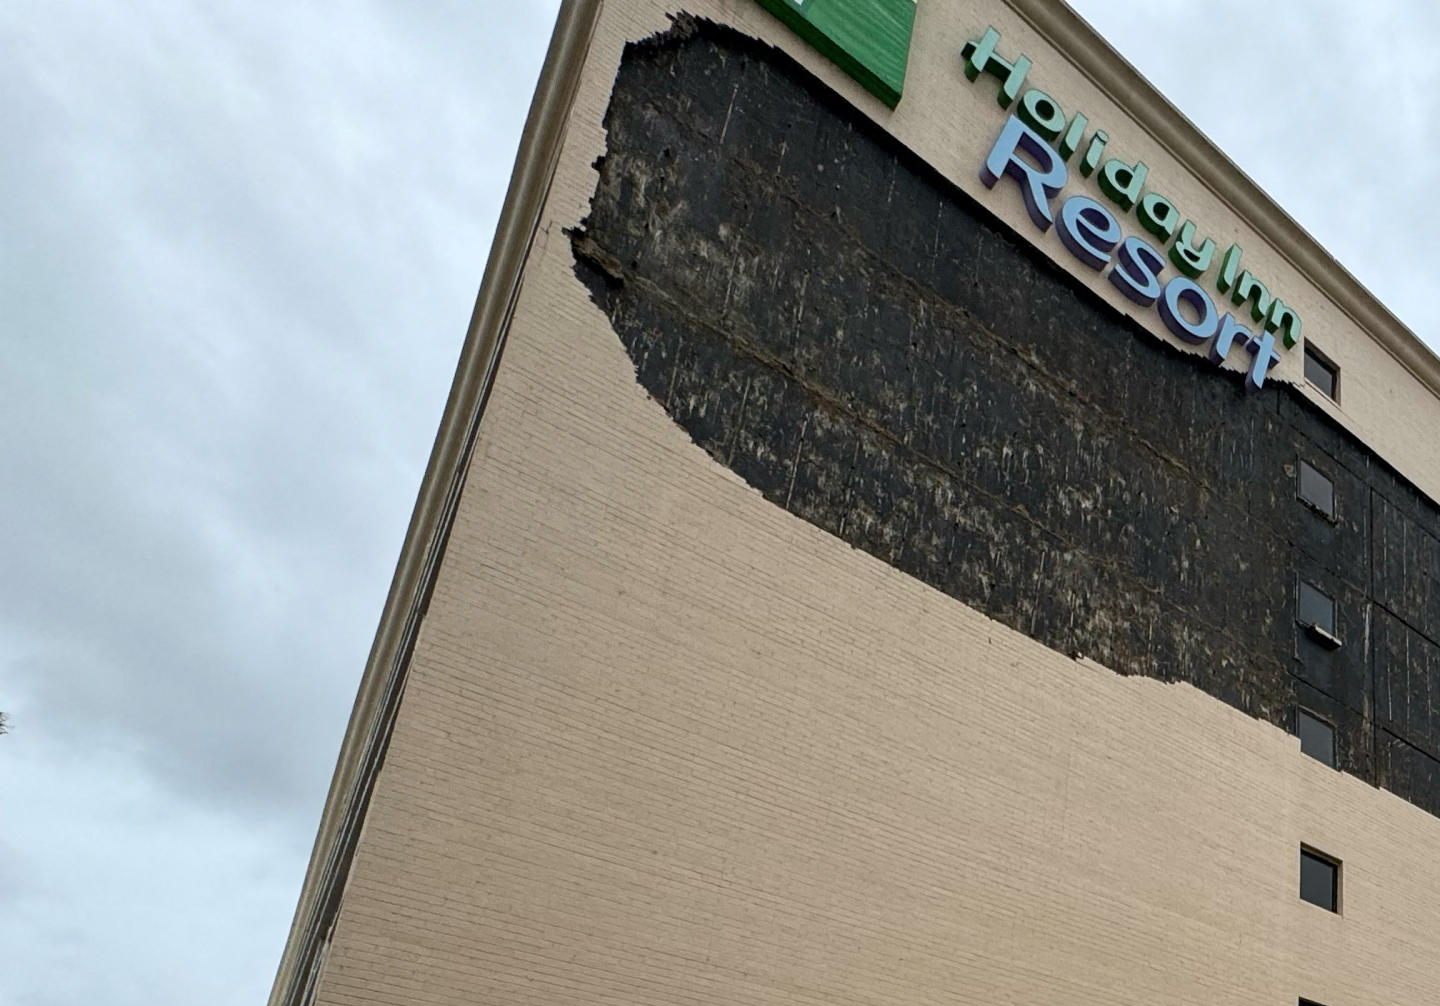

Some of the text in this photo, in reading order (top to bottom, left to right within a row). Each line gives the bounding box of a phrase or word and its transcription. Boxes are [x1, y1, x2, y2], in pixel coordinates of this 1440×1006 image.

[960, 25, 1302, 350] Holiday Inn
[979, 113, 1281, 391] Resort
